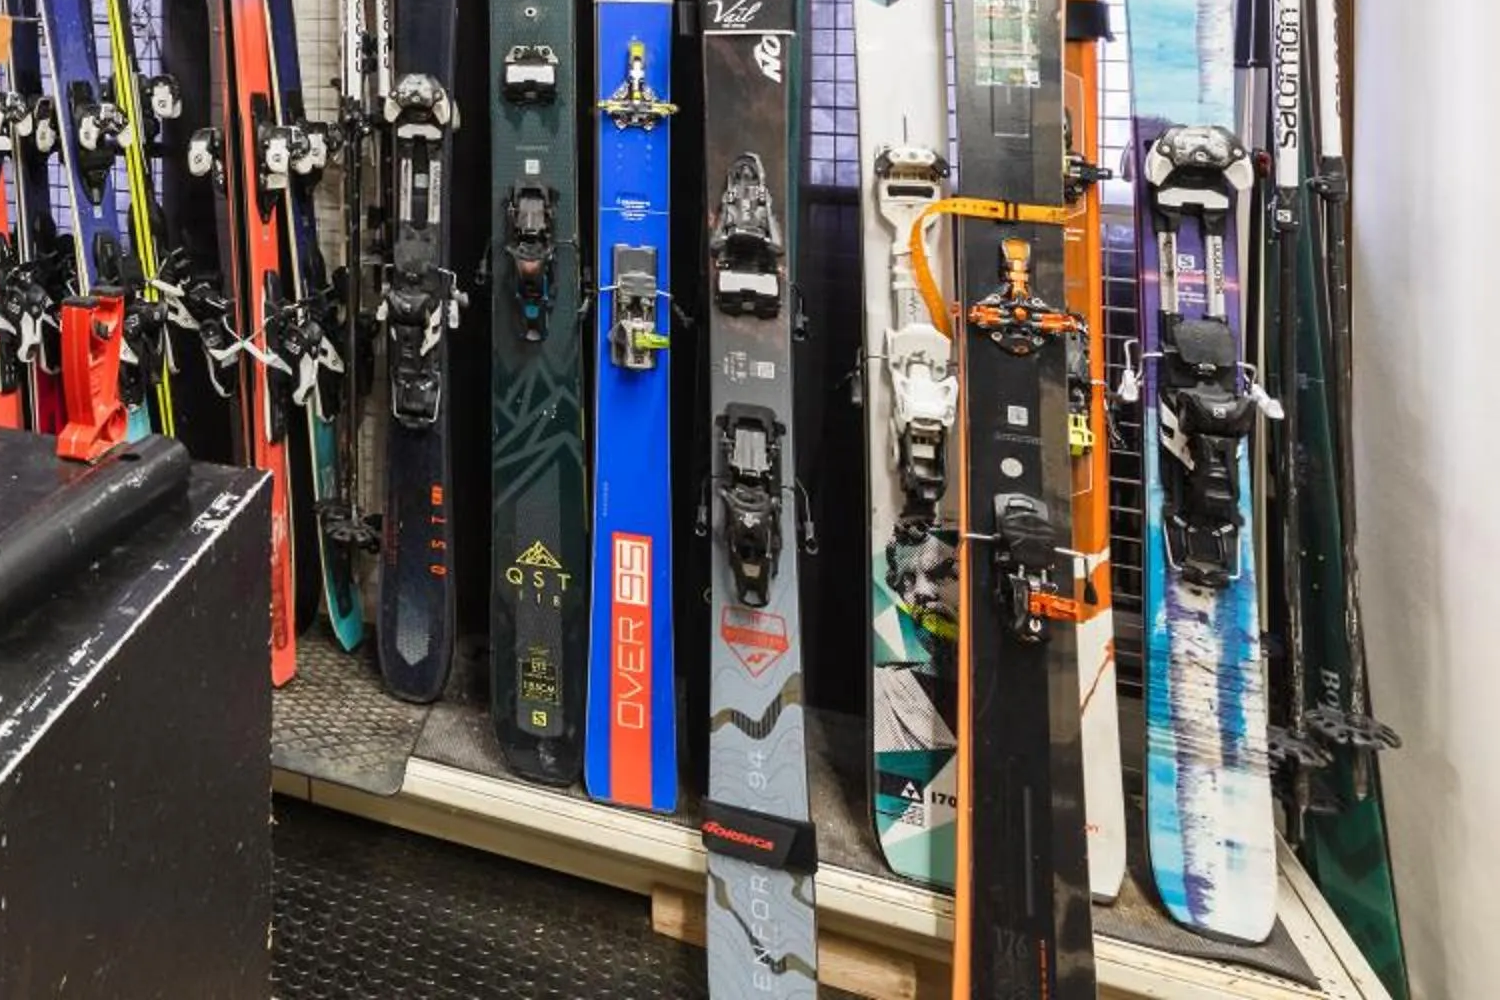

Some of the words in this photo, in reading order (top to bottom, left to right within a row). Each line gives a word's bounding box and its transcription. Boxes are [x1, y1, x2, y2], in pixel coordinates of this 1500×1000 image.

[1280, 7, 1299, 149] salomon
[505, 566, 572, 592] QST
[617, 616, 645, 730] OVER
[749, 749, 768, 790] 94
[931, 791, 958, 809] 170
